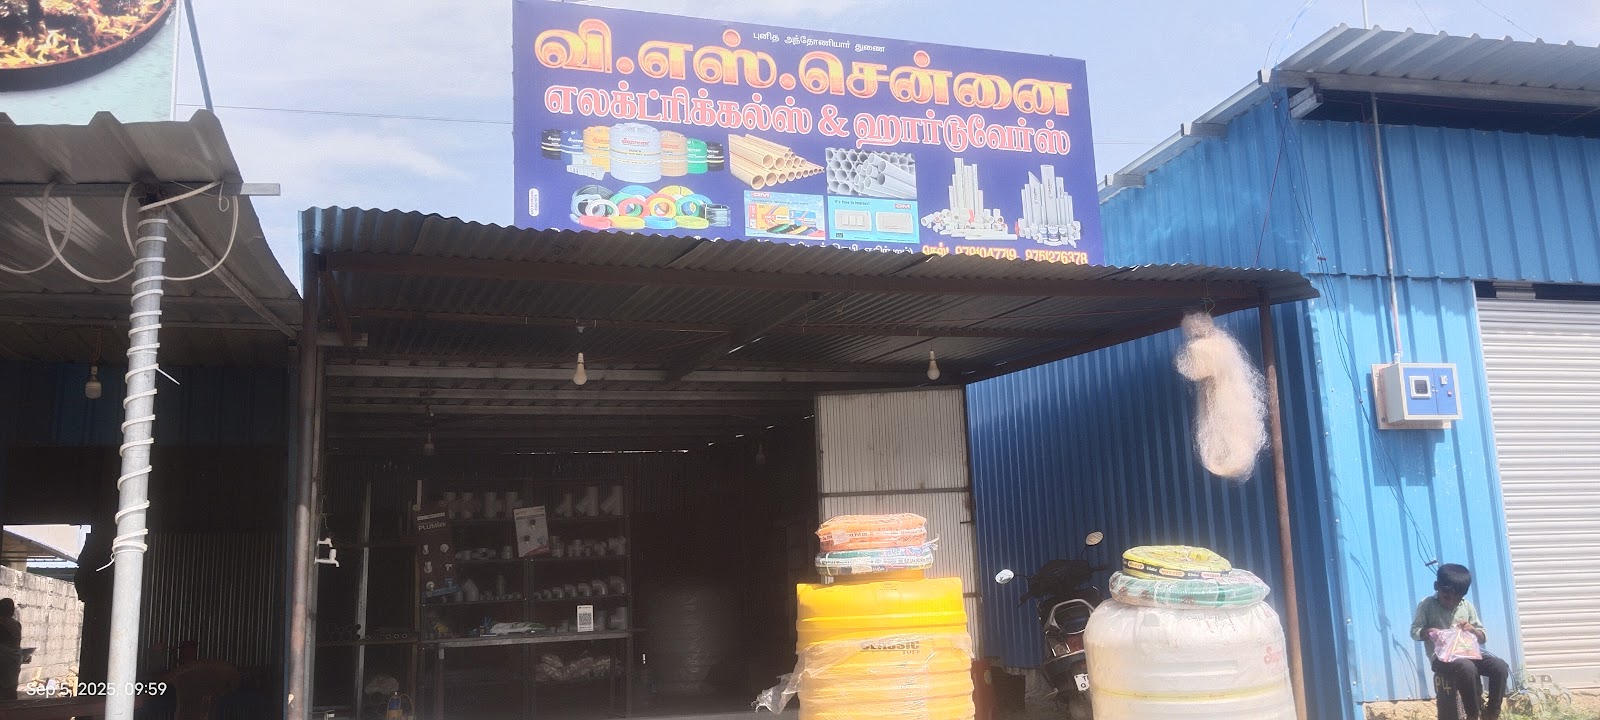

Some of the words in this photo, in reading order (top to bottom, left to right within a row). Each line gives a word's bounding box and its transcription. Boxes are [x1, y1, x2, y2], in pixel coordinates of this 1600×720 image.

[753, 32, 780, 43] புனித
[854, 43, 886, 53] துணை
[817, 104, 850, 137] &
[853, 109, 1071, 156] ஹார்டுவேர்ஸ்
